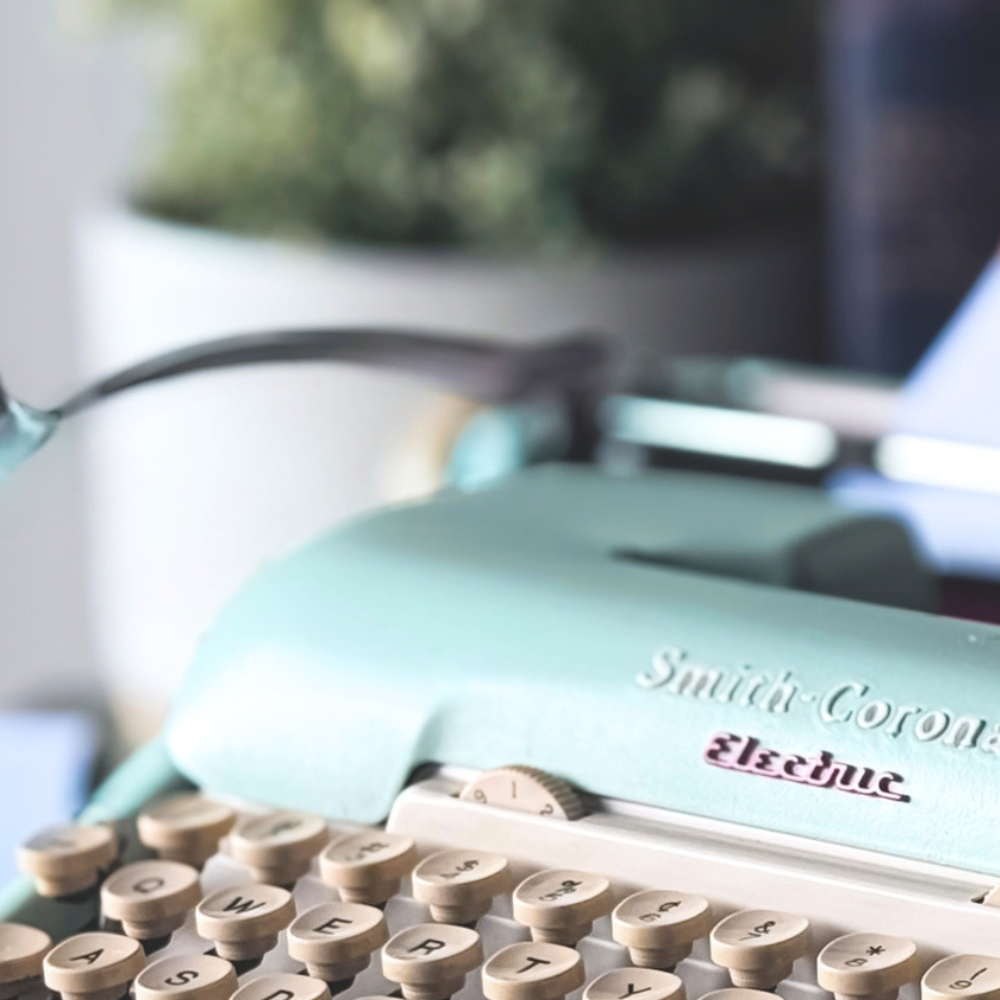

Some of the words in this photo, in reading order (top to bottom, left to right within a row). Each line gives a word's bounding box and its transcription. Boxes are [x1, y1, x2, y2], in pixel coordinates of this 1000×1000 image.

[223, 896, 265, 915] W
[317, 917, 353, 935] E
[407, 938, 446, 955] R
[70, 948, 104, 964] A
[517, 956, 550, 974] T
[165, 970, 199, 986] S
[618, 983, 652, 1000] Y
